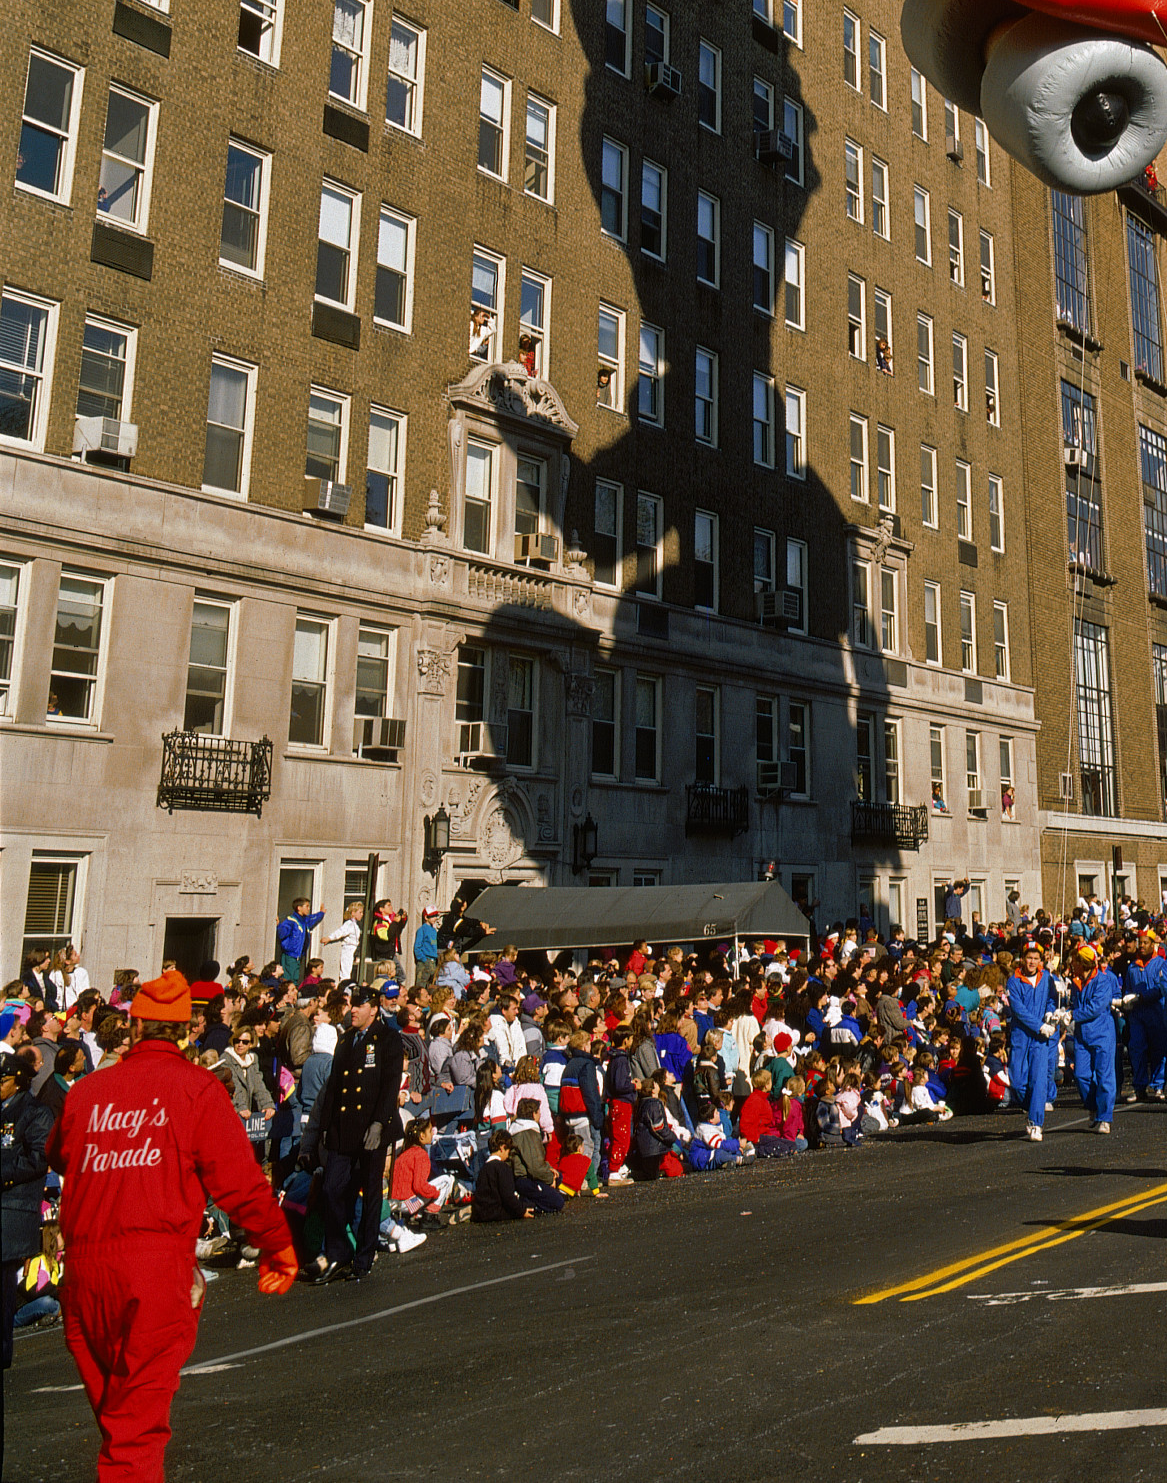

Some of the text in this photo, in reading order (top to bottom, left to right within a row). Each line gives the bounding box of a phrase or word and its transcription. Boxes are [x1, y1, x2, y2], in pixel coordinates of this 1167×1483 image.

[703, 923, 717, 936] 65
[86, 1098, 170, 1138] Macy's
[246, 1117, 266, 1132] LINE
[81, 1137, 162, 1173] Parade
